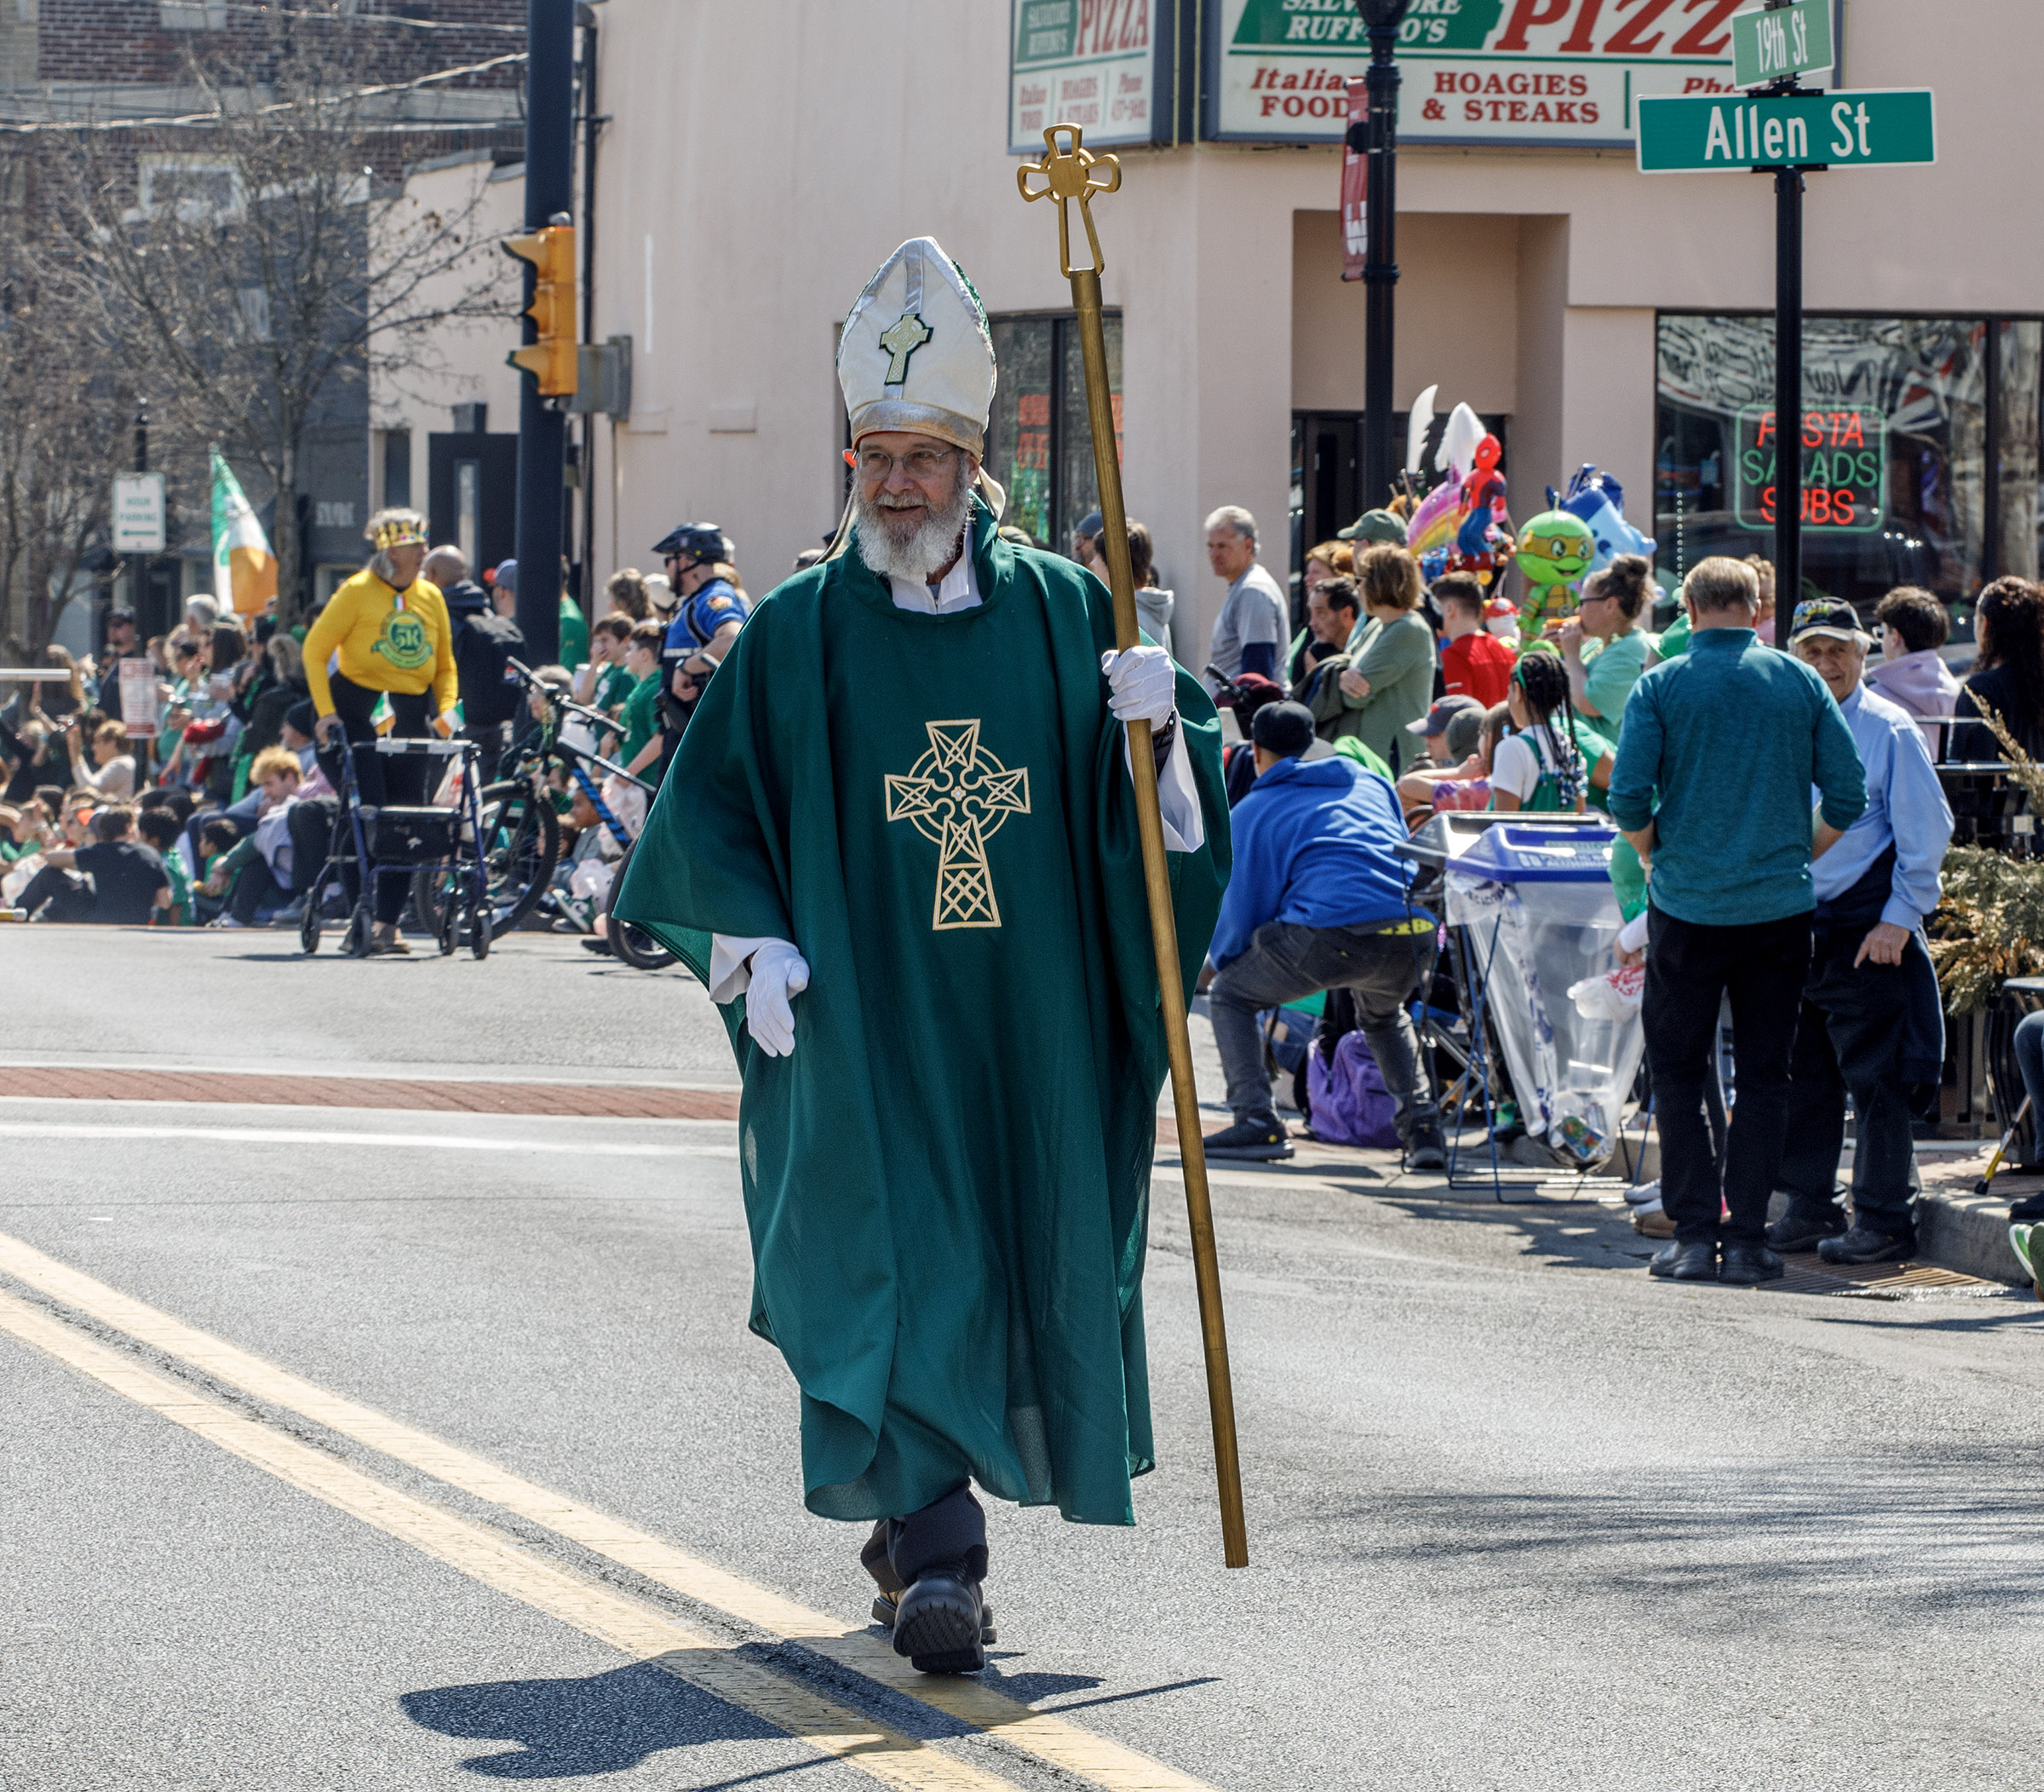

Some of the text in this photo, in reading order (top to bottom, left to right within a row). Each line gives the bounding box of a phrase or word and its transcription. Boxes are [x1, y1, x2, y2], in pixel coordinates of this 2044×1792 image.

[1077, 0, 1148, 55] PIZZA
[1285, 15, 1448, 43] RUFFO'S
[1493, 0, 1732, 55] PIZZ
[1756, 9, 1808, 74] 19th St
[1250, 68, 1364, 91] Italia
[1434, 72, 1588, 96] HOAGIES
[1260, 95, 1350, 118] FOOD
[1421, 98, 1600, 123] & STEAKS
[1704, 101, 1872, 161] Allen St
[1757, 412, 1864, 447] PSTA
